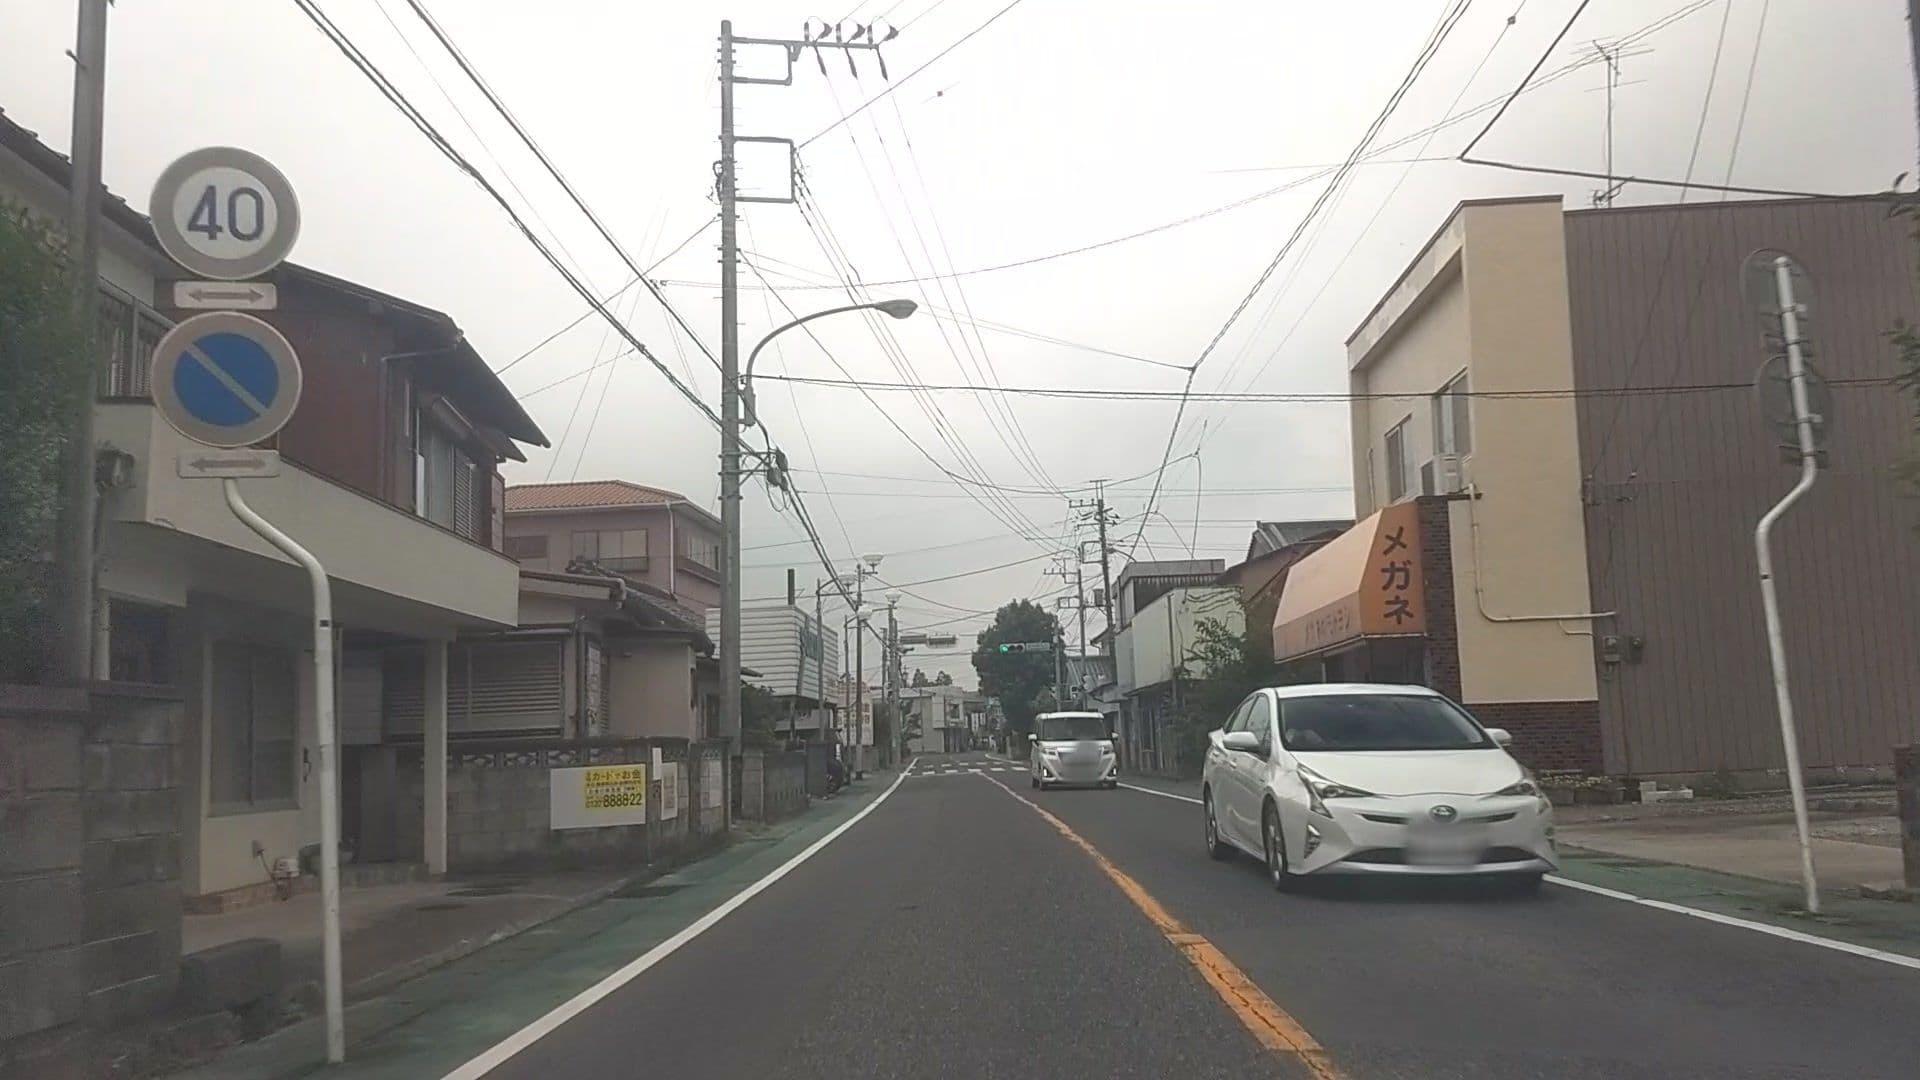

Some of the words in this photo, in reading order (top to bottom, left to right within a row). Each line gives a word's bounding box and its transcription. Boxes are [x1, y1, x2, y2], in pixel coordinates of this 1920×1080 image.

[187, 185, 265, 242] 40
[1381, 526, 1414, 625] メガネ
